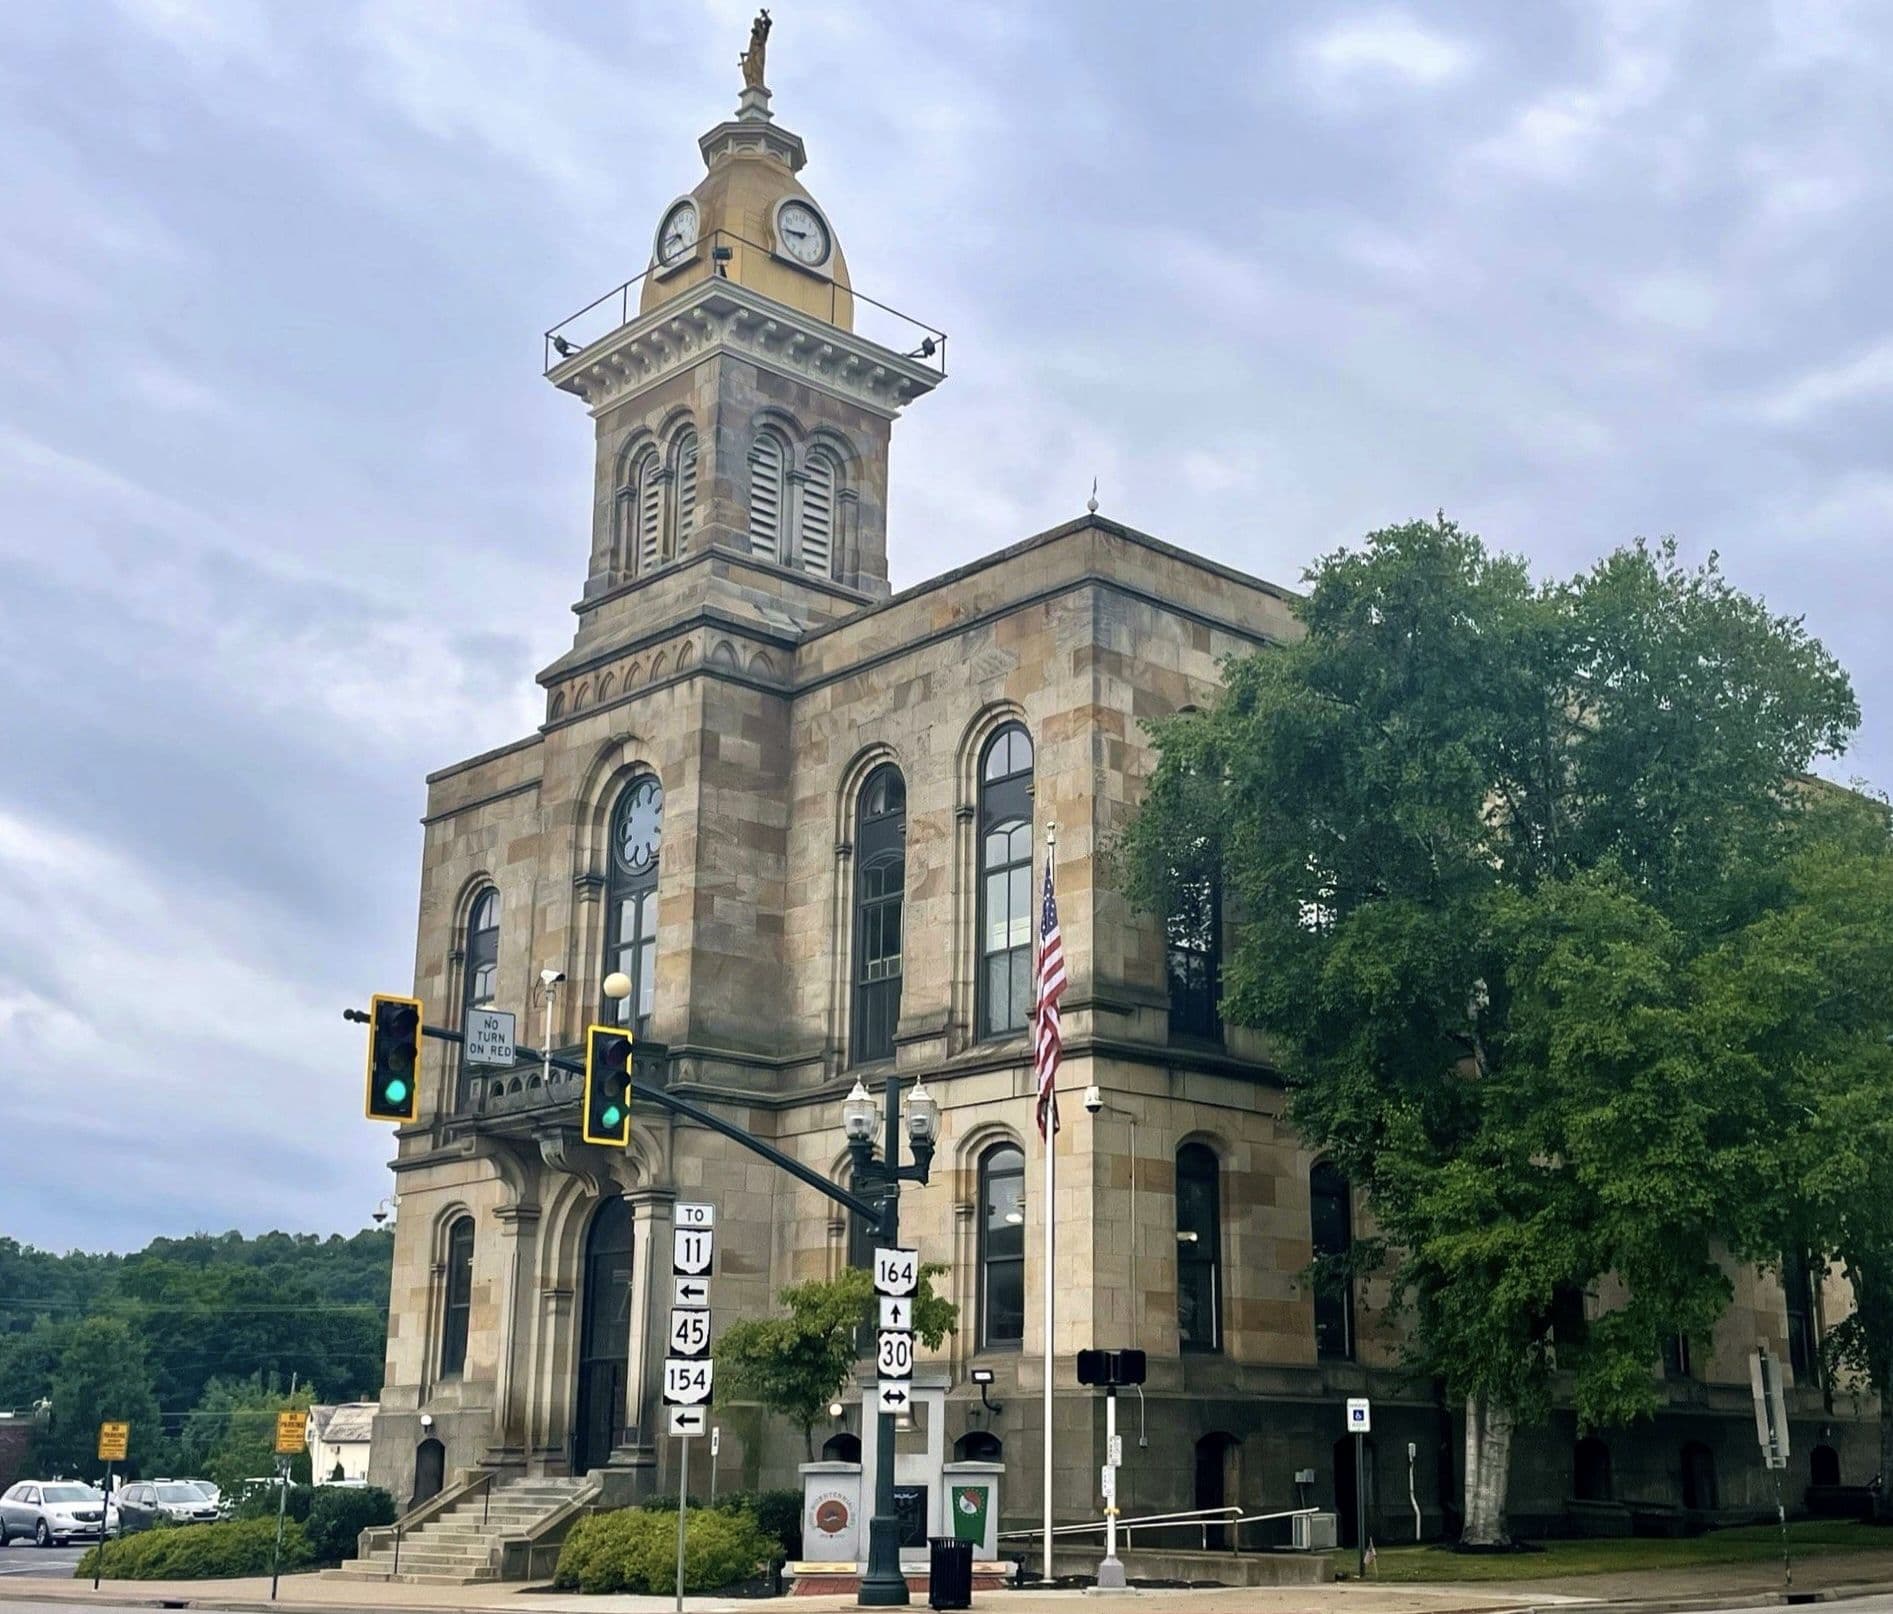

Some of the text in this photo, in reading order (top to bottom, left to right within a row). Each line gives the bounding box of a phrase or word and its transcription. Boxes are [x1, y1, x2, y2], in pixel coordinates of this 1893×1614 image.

[484, 1019, 499, 1030] NO
[478, 1031, 505, 1044] TURN
[469, 1044, 511, 1057] ON RED
[685, 1208, 704, 1222] TO
[684, 1237, 702, 1264] 11
[880, 1260, 913, 1284] 164
[675, 1318, 704, 1345] 45
[882, 1341, 908, 1368] 30
[669, 1368, 706, 1391] 154
